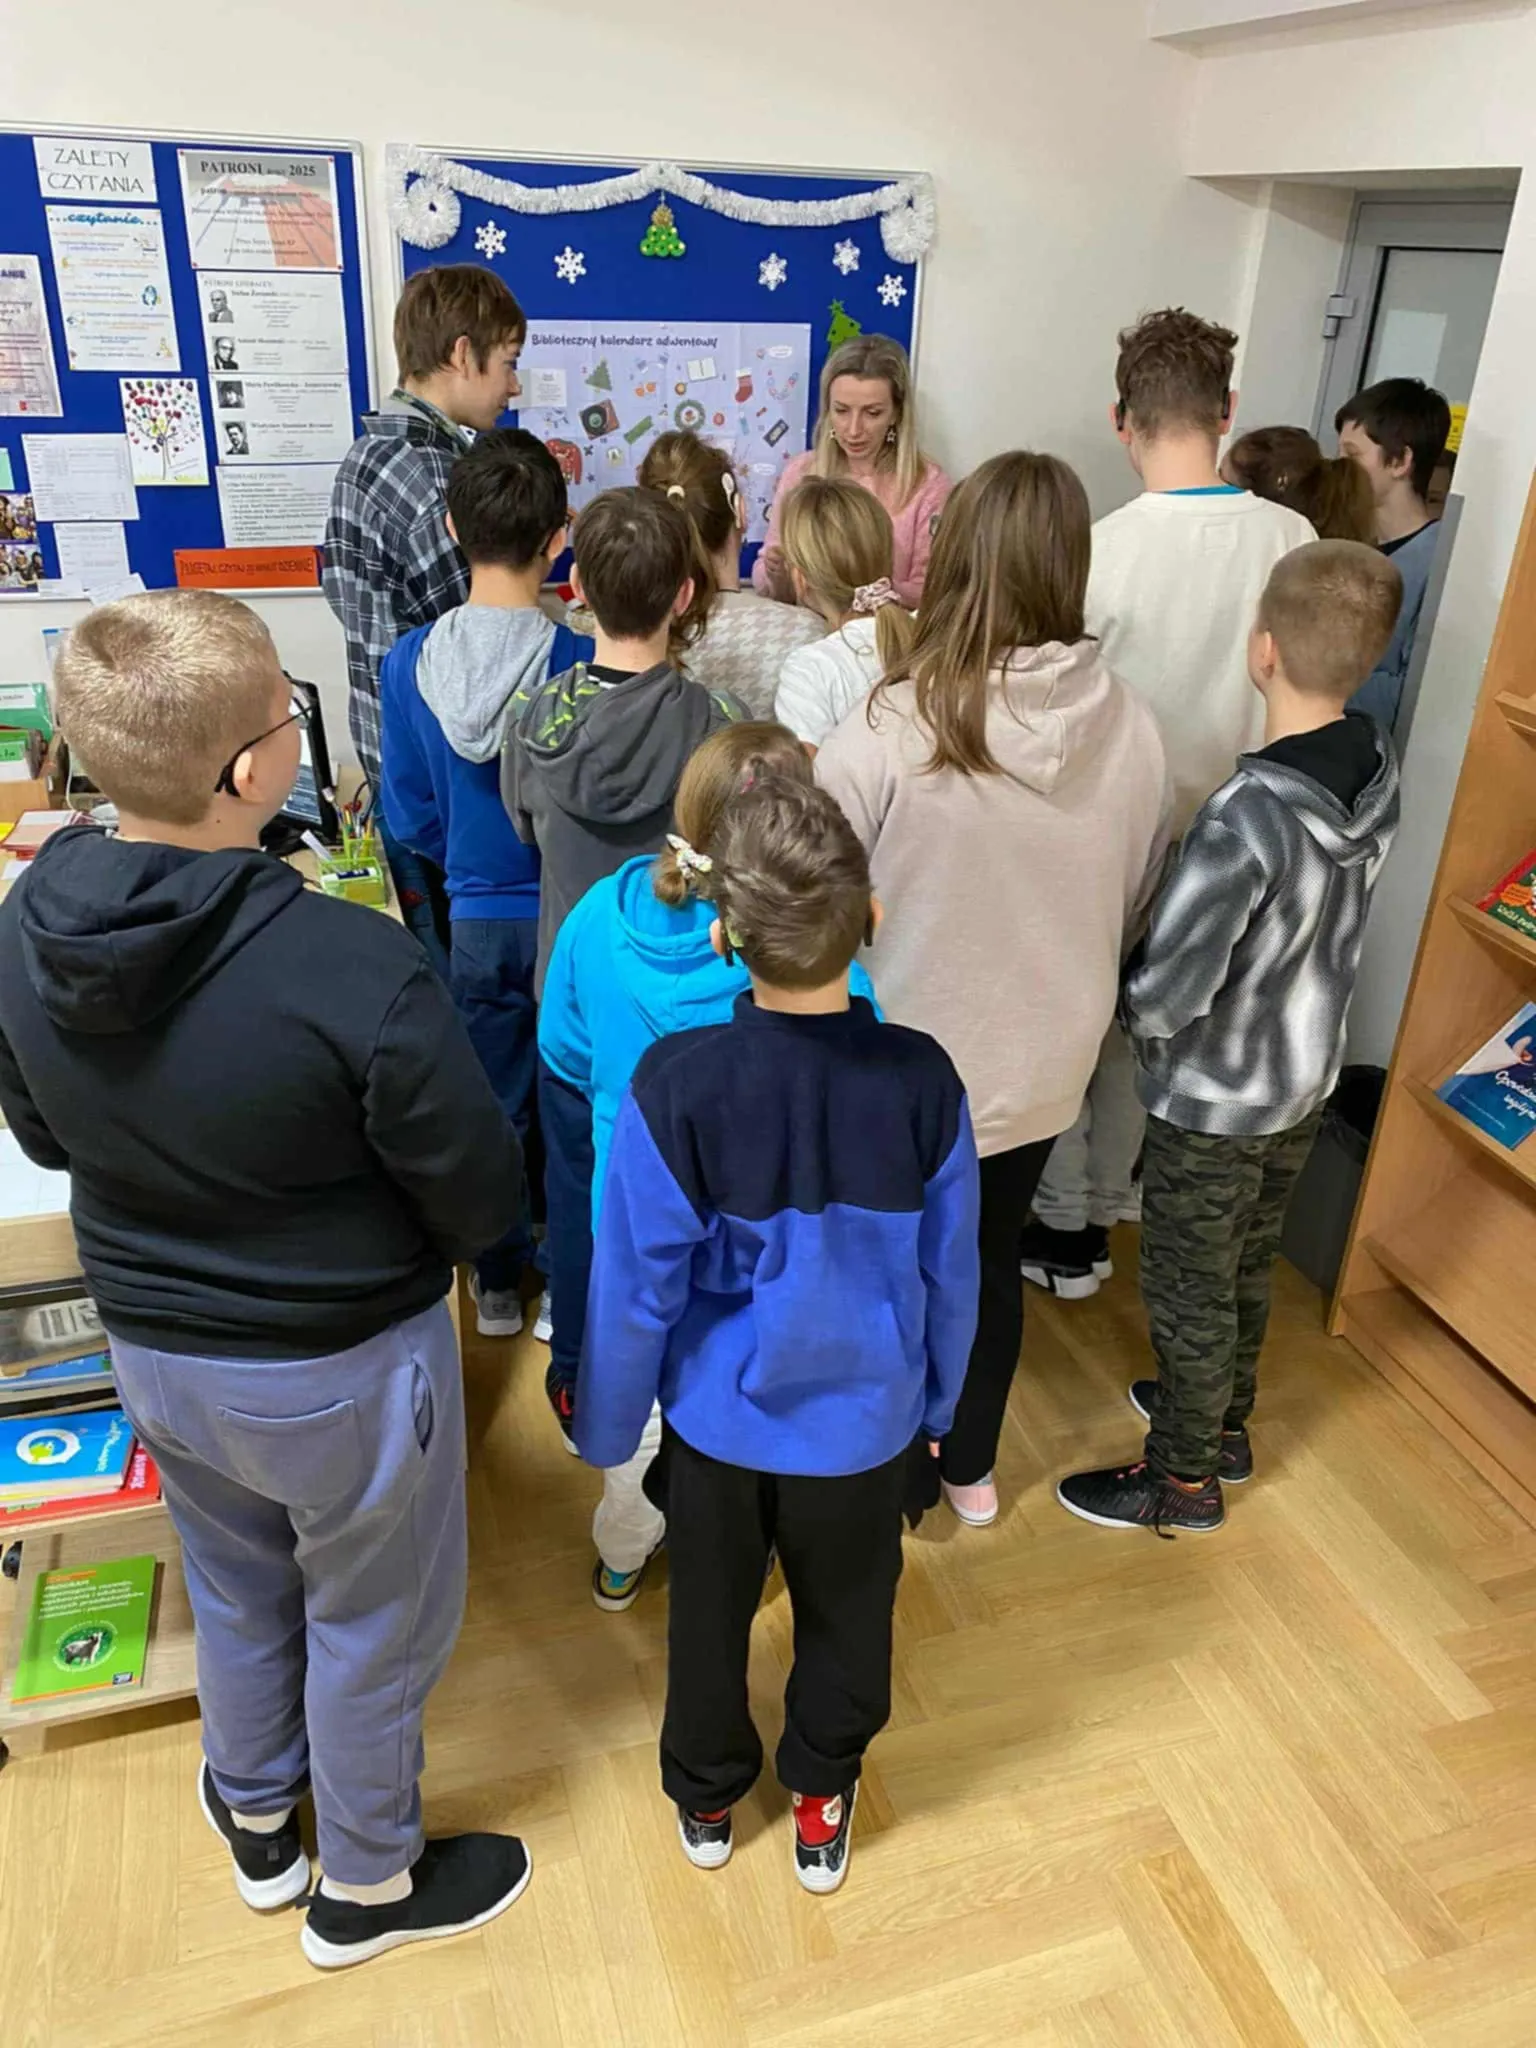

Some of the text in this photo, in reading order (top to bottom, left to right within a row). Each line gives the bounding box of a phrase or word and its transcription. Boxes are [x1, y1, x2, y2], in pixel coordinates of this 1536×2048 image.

[54, 148, 130, 168] ZALETY
[200, 160, 263, 175] PATRONI
[289, 165, 317, 177] 2025
[47, 172, 145, 194] CZYTANIA
[531, 334, 718, 349] Biblioteczny kalendarz adwentowy
